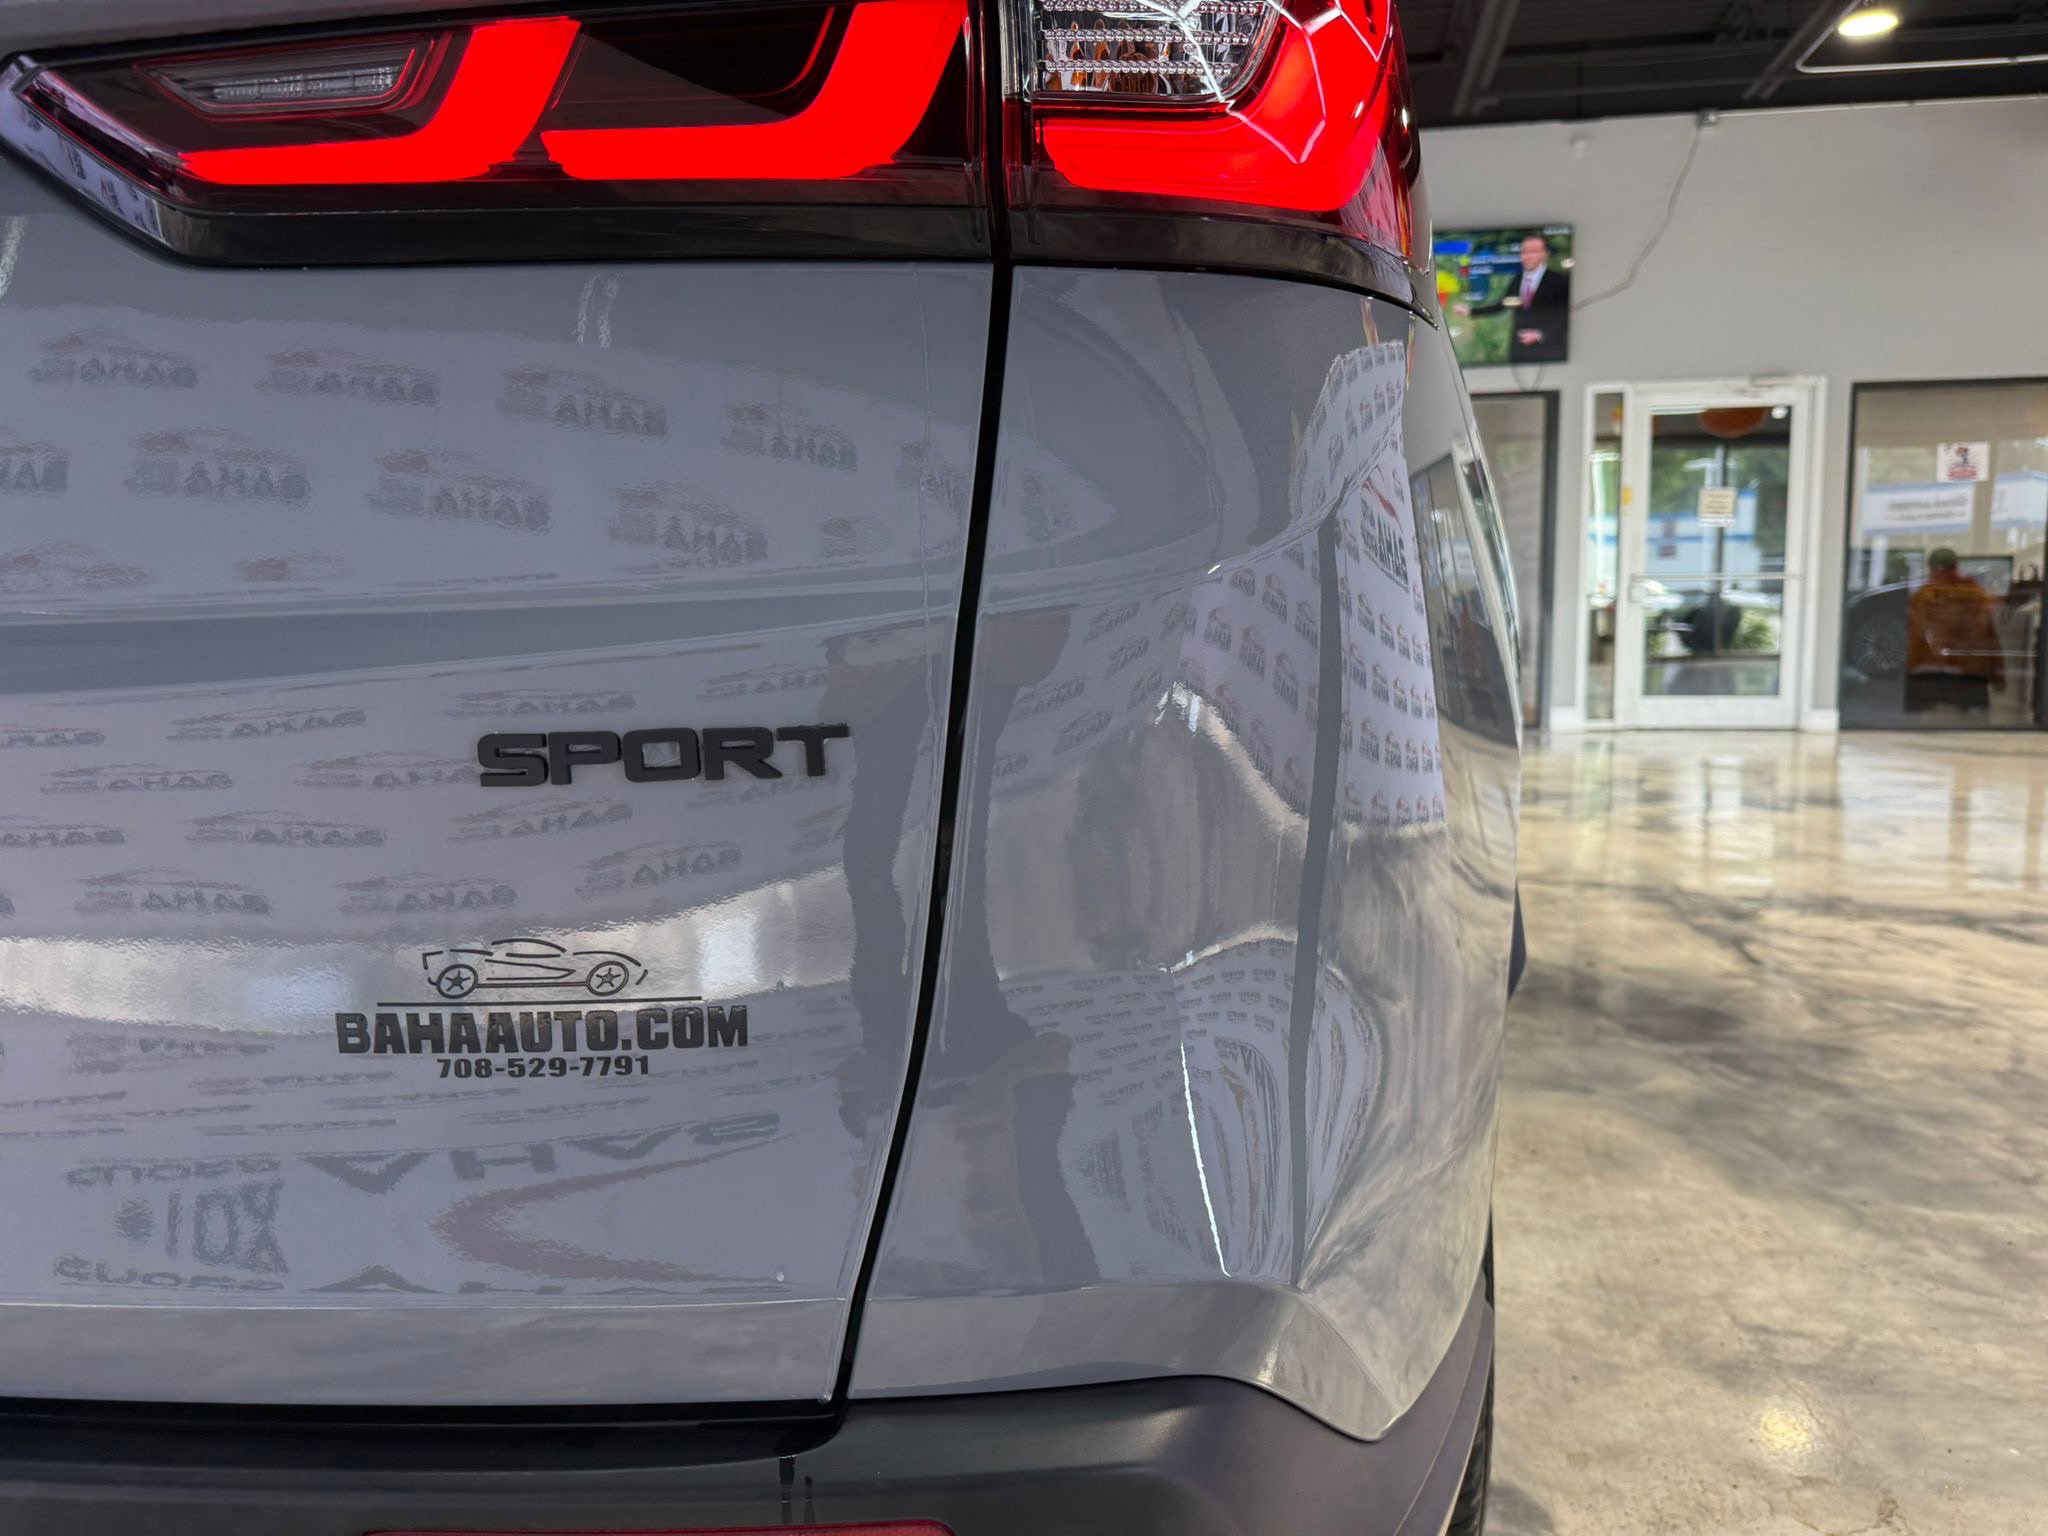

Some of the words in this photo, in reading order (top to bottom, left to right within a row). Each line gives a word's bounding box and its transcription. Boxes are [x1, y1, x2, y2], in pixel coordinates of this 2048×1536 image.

[477, 723, 850, 788] SPORT
[335, 1005, 749, 1054] BAHAAUTO.COM
[436, 1055, 650, 1079] 708-529-7791
